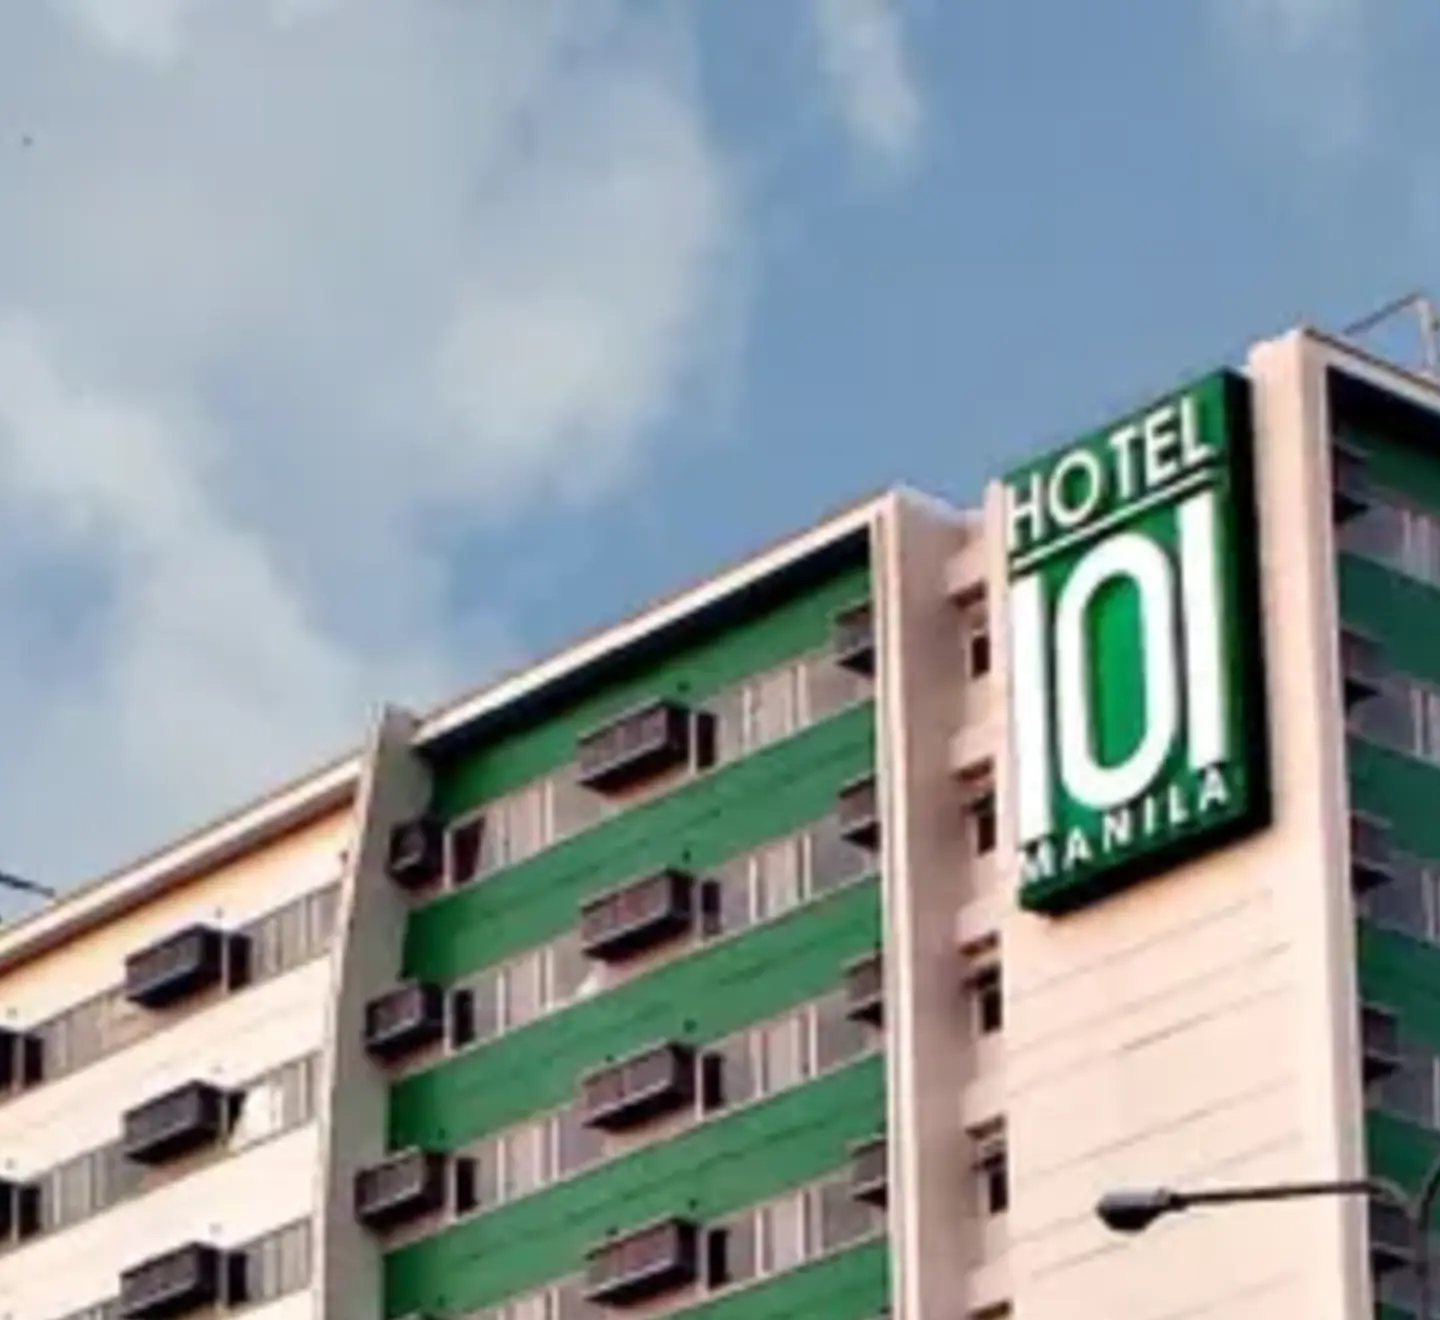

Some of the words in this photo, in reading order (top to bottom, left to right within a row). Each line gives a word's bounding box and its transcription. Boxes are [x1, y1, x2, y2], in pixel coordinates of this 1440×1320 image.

[1006, 396, 1215, 549] HOTEL
[1009, 488, 1227, 843] 101
[1019, 764, 1230, 884] MANILA
